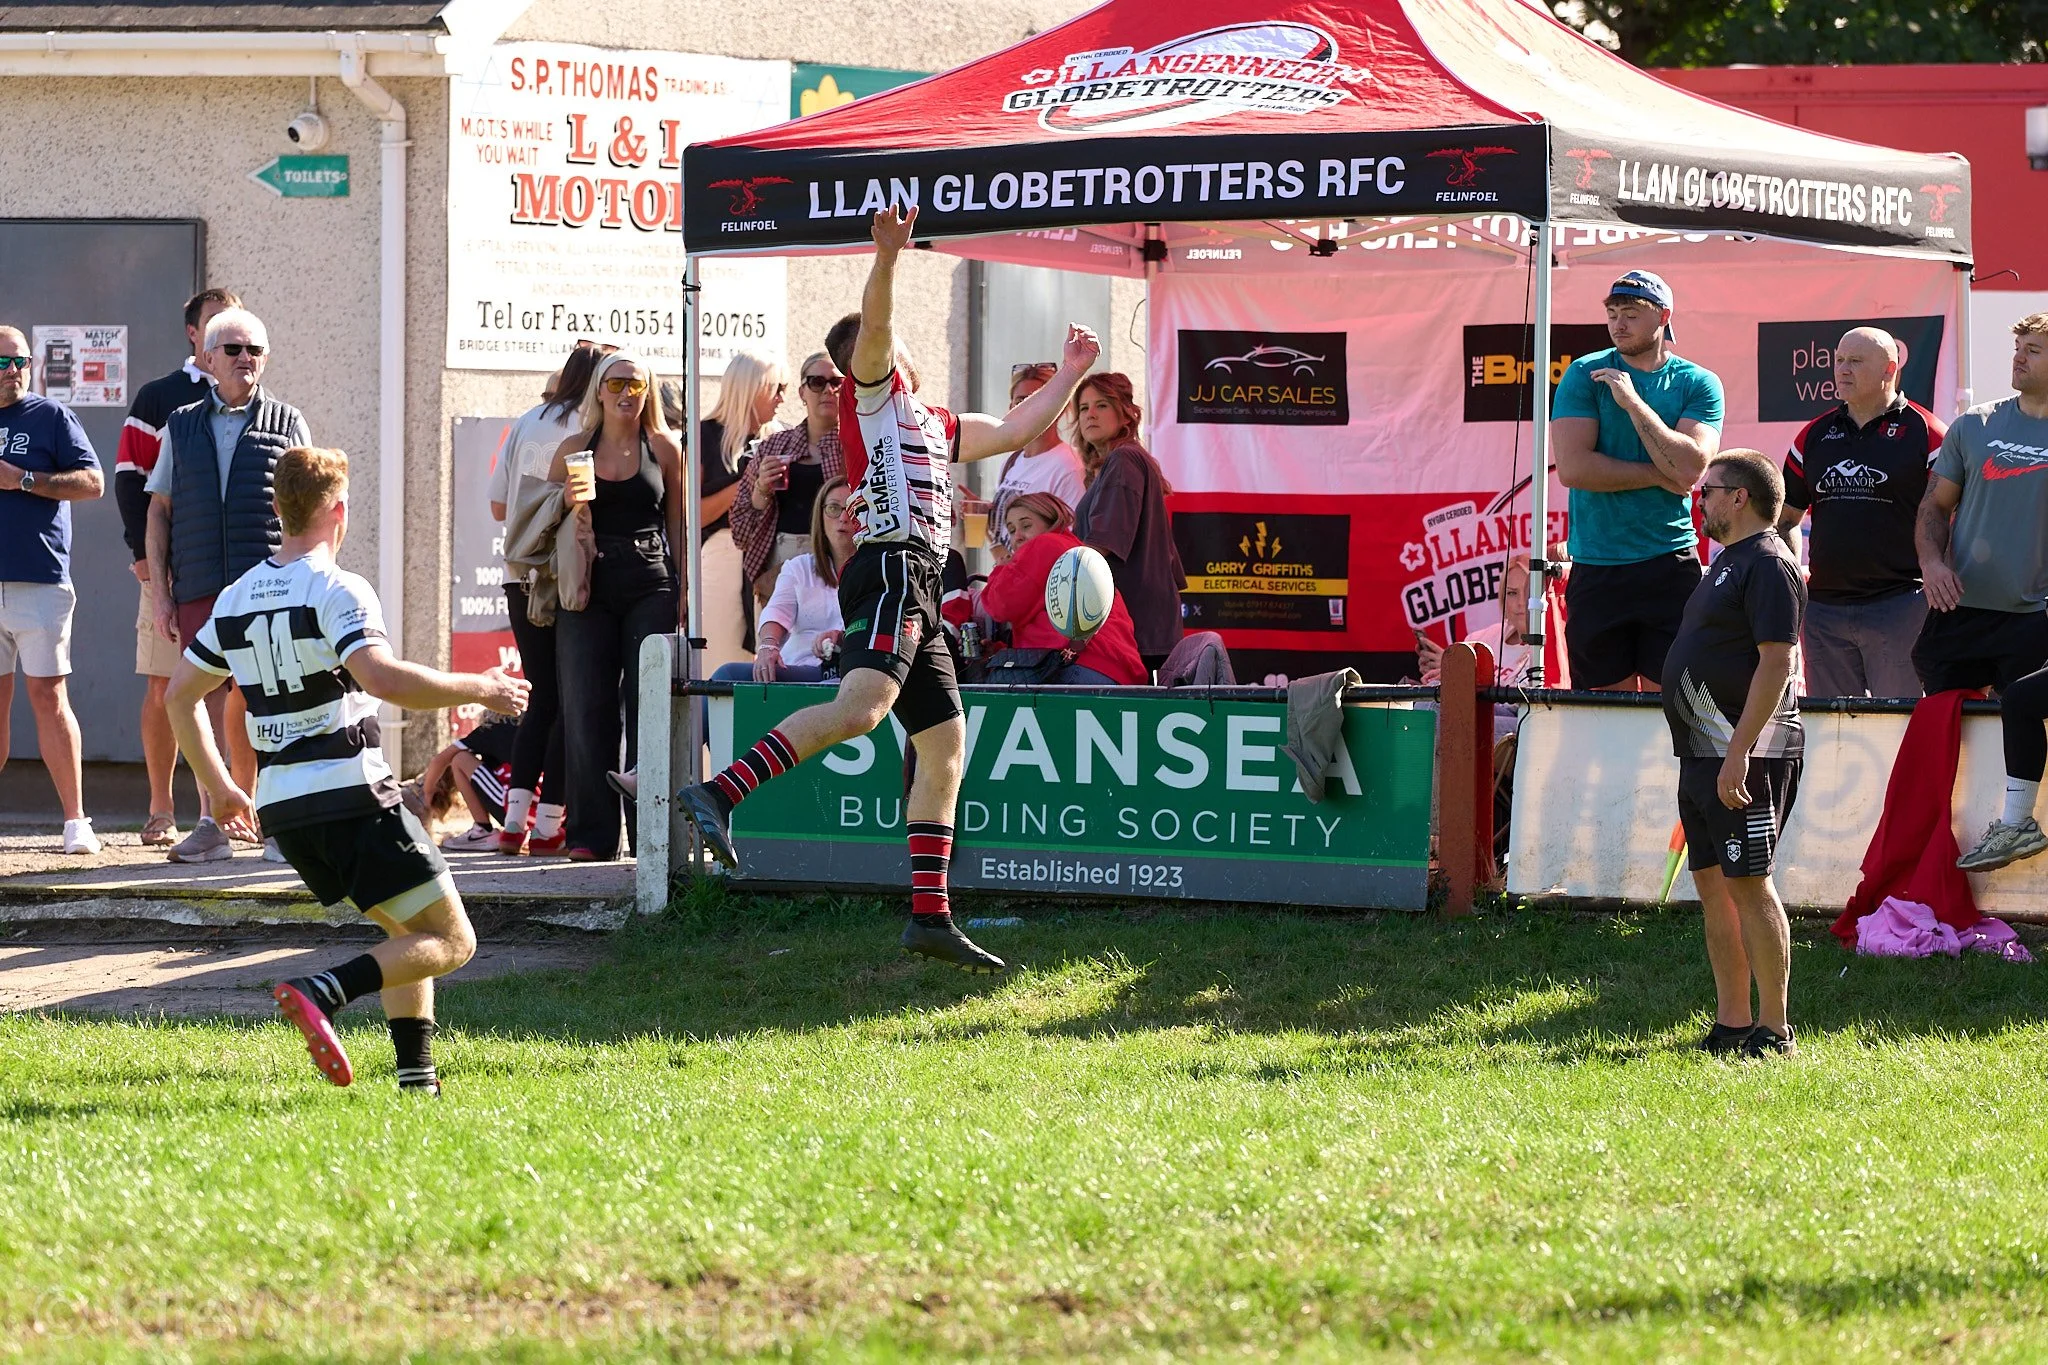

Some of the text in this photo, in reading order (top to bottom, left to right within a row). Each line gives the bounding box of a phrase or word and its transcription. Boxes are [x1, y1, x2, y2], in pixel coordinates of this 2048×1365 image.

[1062, 53, 1348, 84] LLANGENNECH
[1008, 77, 1348, 112] GLOBETROTTERS
[513, 120, 553, 141] WHILE
[567, 113, 597, 164] L
[609, 116, 648, 168] &
[477, 144, 539, 166] YOU WAIT
[284, 170, 340, 184] TOILETS
[808, 156, 1405, 219] LLAN GLOBETROTTERS RFC
[1435, 190, 1499, 203] FELINFOEL
[1570, 192, 1601, 206] FELINFOEL
[1617, 159, 1912, 226] LLAN GLOBETROTTERS RFC
[720, 219, 778, 233] FELINFOEL
[1925, 225, 1956, 239] FELINFOEL
[477, 301, 513, 330] Tel
[521, 310, 545, 332] or
[552, 304, 603, 333] Fax:
[610, 309, 675, 336] 01554
[85, 331, 120, 340] MATCH
[92, 340, 111, 349] DAY
[459, 339, 500, 352] BRIDGE
[504, 341, 546, 354] STREET
[1793, 341, 1837, 376] pla
[1472, 356, 1483, 387] THE
[1189, 385, 1336, 404] JJ CAR SALES
[10, 432, 30, 455] 2
[883, 435, 900, 512] ADVERTISING
[1825, 477, 1875, 488] MANNOR
[1206, 562, 1313, 576] GARRY GRIFFITHS
[1204, 579, 1317, 592] ELECTRICAL SERVICES
[460, 597, 494, 616] 100%
[244, 611, 305, 697] 14
[304, 713, 330, 725] Young
[1117, 808, 1342, 848] SOCIETY
[981, 857, 1184, 889] Established 1923
